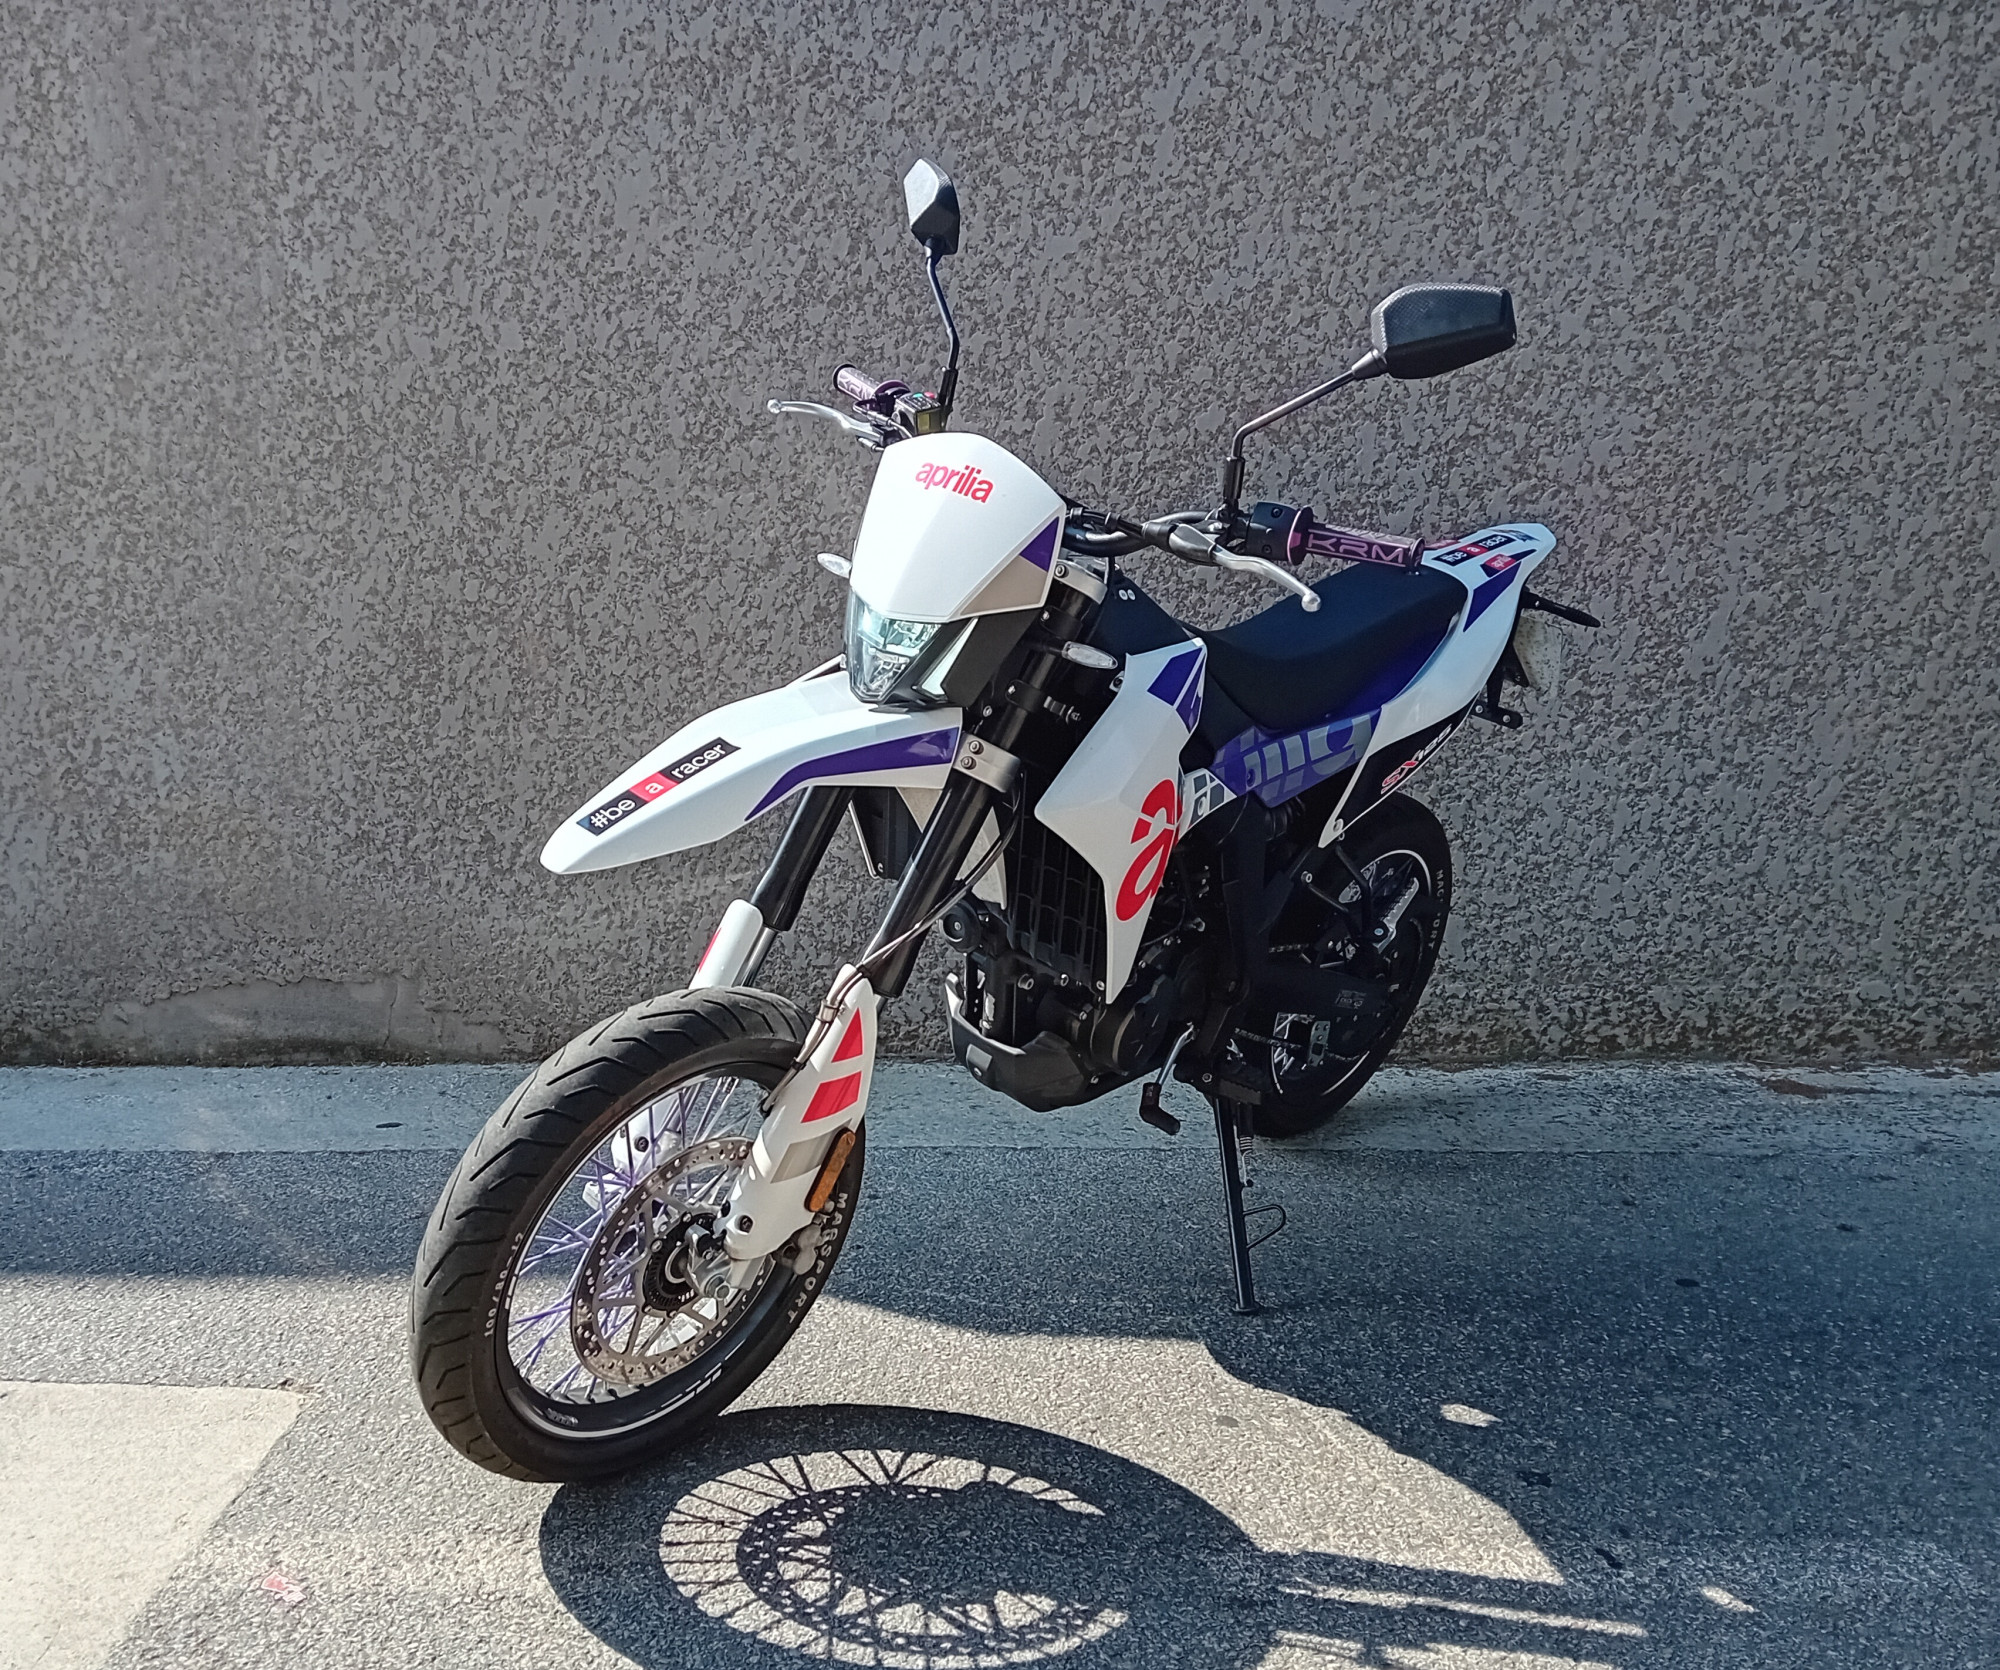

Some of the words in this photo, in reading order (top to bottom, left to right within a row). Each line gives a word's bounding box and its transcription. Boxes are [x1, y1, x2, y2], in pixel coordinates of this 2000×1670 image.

[914, 462, 994, 503] aprilia
[1307, 533, 1405, 564] KRM
[590, 799, 636, 829] #be
[645, 782, 665, 795] a
[671, 744, 726, 780] racer
